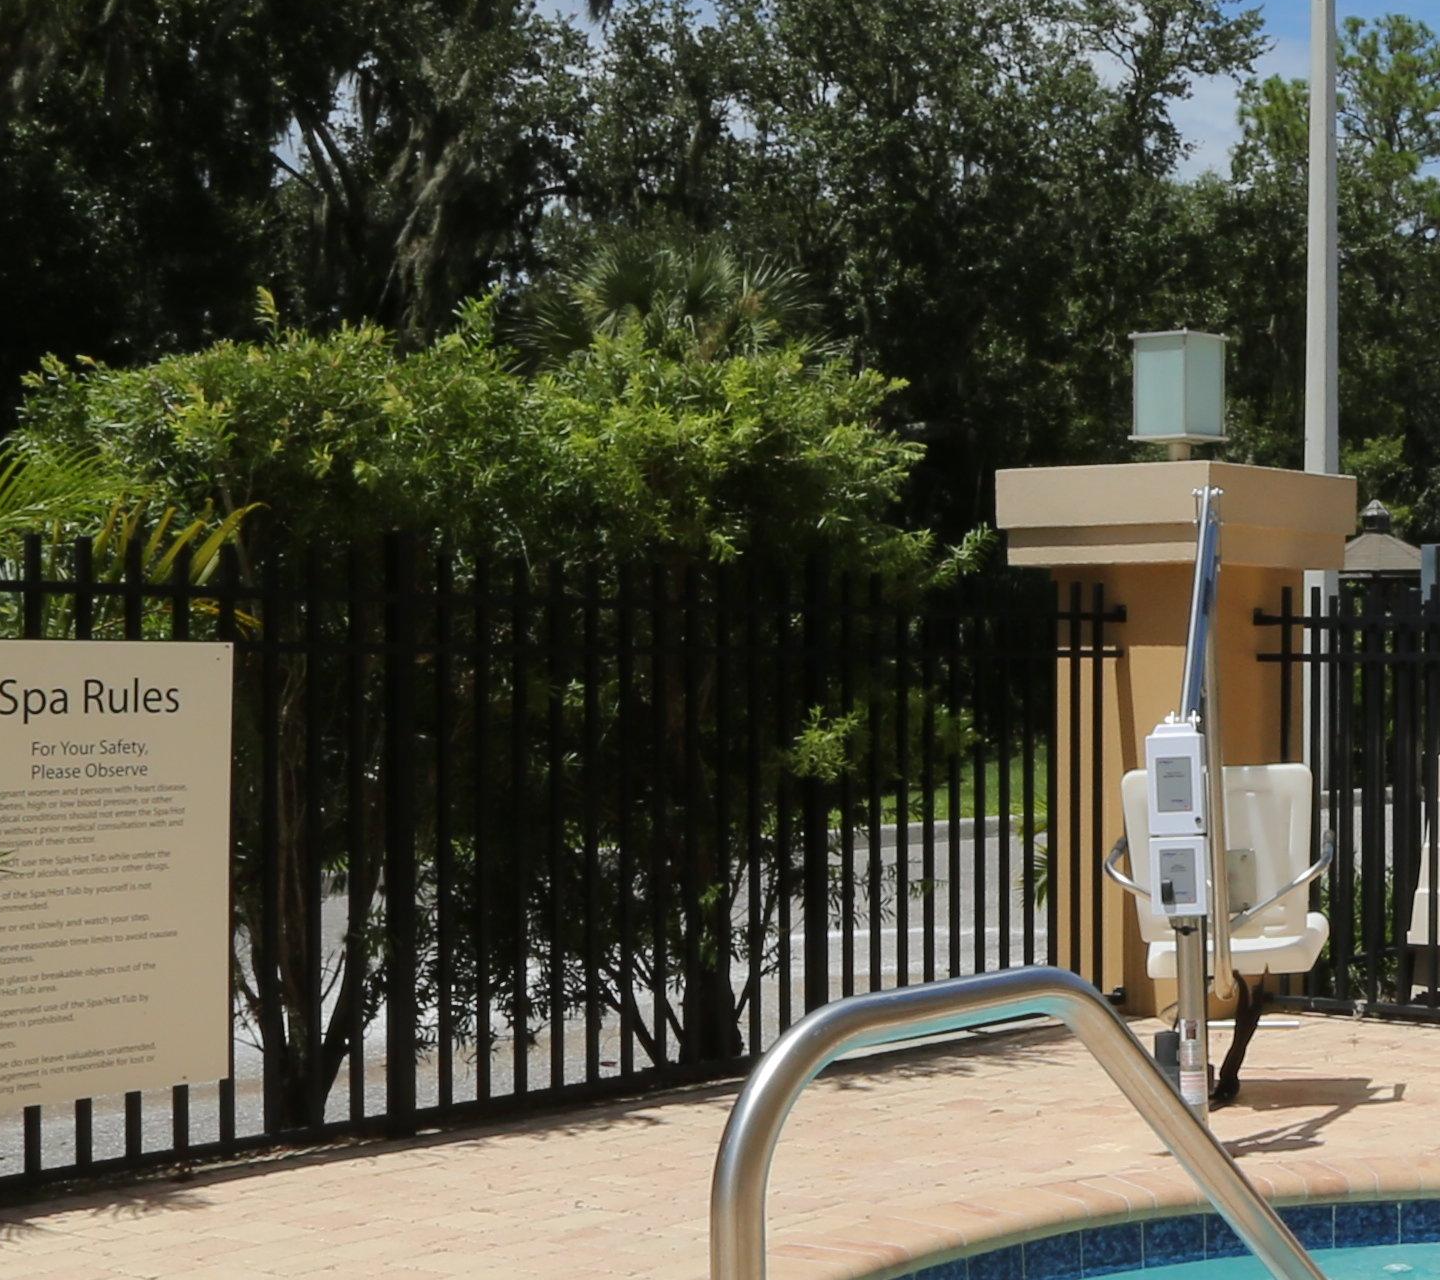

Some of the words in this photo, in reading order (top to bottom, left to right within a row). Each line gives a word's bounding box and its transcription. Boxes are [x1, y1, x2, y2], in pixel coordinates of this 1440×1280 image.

[84, 678, 179, 713] Rules
[32, 741, 56, 756] For
[60, 741, 94, 755] Your
[99, 739, 148, 756] Safety,
[32, 765, 81, 779] Please
[85, 763, 148, 776] Observe
[27, 789, 60, 797] women
[80, 788, 113, 796] persons
[134, 784, 155, 792] heart
[27, 800, 46, 810] high
[49, 801, 57, 809] or
[77, 798, 102, 806] blood
[151, 796, 172, 804] other
[22, 813, 67, 821] conditions
[69, 811, 97, 819] should
[115, 810, 137, 818] enter
[153, 807, 185, 816] Spa/Hot
[40, 826, 61, 834] prior
[62, 824, 95, 832] medical
[97, 822, 147, 830] consultation
[149, 820, 166, 828] with
[168, 819, 183, 827] and
[34, 838, 45, 846] of
[46, 837, 65, 845] their
[39, 857, 54, 865] the
[55, 855, 89, 864] Spa/Hot
[91, 853, 106, 861] Tub
[109, 852, 130, 860] while
[132, 851, 156, 859] under
[158, 850, 170, 858] the
[27, 871, 36, 879] of
[3, 892, 11, 901] of
[13, 891, 28, 899] the
[30, 889, 64, 899] Spa/Hot
[66, 887, 81, 895] Tub
[83, 886, 94, 895] by
[95, 884, 128, 893] yourself
[19, 923, 35, 931] exit
[38, 920, 64, 930] slowly
[66, 918, 82, 927] and
[84, 916, 109, 925] watch
[111, 916, 130, 925] your
[21, 940, 68, 950] reasonable
[90, 935, 113, 944] limits
[126, 932, 147, 941] avoid
[150, 930, 178, 938] nausea
[6, 975, 28, 986] glass
[30, 974, 39, 982] or
[41, 969, 83, 980] breakable
[85, 966, 115, 977] objects
[117, 964, 131, 972] out
[132, 962, 142, 971] of
[143, 961, 156, 969] the
[20, 986, 36, 994] Tub
[60, 1001, 69, 1010] of
[71, 1000, 85, 1009] the
[87, 997, 120, 1009] Spa/Hot
[139, 994, 149, 1003] by
[11, 1059, 22, 1067] do
[25, 1057, 39, 1066] not
[41, 1054, 64, 1063] leave
[66, 1050, 105, 1060] valuables
[50, 1066, 65, 1074] not
[66, 1060, 114, 1072] responsible
[116, 1057, 128, 1066] for
[130, 1055, 144, 1064] lost
